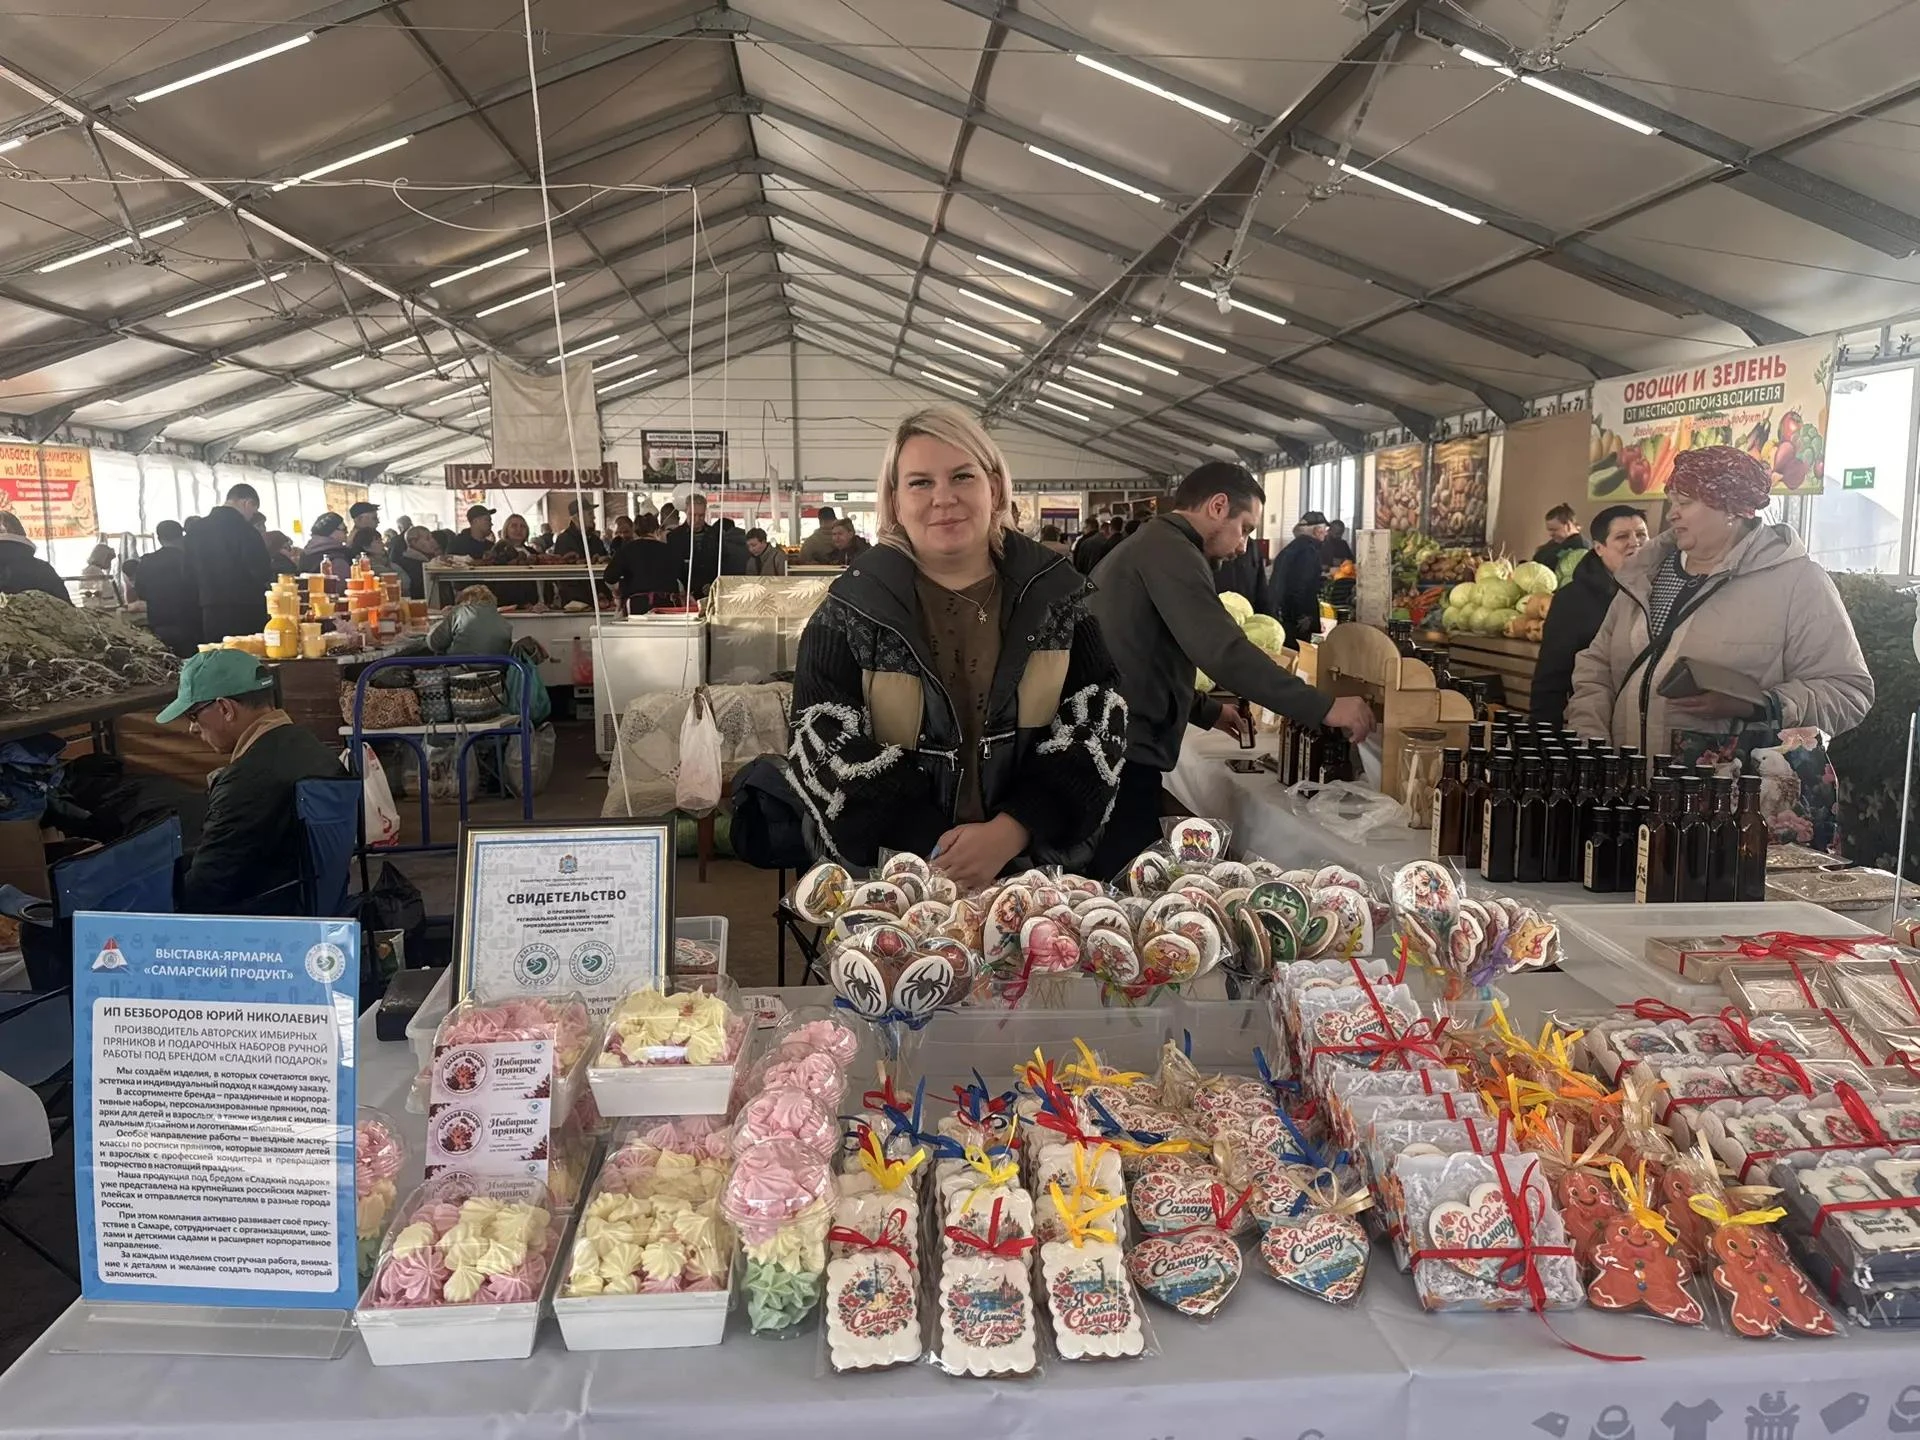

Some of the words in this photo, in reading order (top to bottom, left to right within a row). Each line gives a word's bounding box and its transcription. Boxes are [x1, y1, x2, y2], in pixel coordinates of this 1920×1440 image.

[1624, 371, 1687, 403] ОВОЩИ
[1693, 369, 1706, 391] И
[1712, 354, 1787, 388] ЗЕЛЕНЬ
[1625, 407, 1637, 421] ОТ
[1638, 400, 1686, 419] МЕСТНОГО
[1688, 385, 1782, 411] ПРОИЗВОДИТЕЛЯ
[507, 890, 626, 906] СВИДЕТЕЛЬСТВО
[155, 948, 283, 964] ВЫСТАВКА-ЯРМАРКА
[143, 964, 228, 979] «САМАРСКИЙ
[230, 967, 294, 982] ПРОДУКТ»
[103, 1006, 120, 1017] ИП
[124, 1007, 202, 1021] БЕЗБОРОДОВ
[206, 1008, 242, 1021] ЮРИЙ
[246, 1011, 327, 1024] НИКОЛАЕВИЧ
[114, 1024, 198, 1038] ПРОИЗВОДИТЕЛЬ
[201, 1028, 256, 1038] АВТОРСКИХ
[259, 1030, 316, 1040] ИМБИРНЫХ
[1340, 1020, 1385, 1042] Самару
[103, 1037, 155, 1047] ПРЯНИКОВ
[158, 1039, 165, 1047] И
[168, 1039, 236, 1051] ПОДАРОЧНЫХ
[239, 1041, 285, 1051] НАБОРОВ
[288, 1042, 327, 1053] РУЧНОЙ
[103, 1049, 141, 1058] РАБОТЫ
[144, 1050, 165, 1061] ПОД
[168, 1051, 215, 1063] БРЕНДОМ
[219, 1051, 271, 1065] «СЛАДКИЙ
[275, 1055, 327, 1067] ПОДАРОК»
[492, 1057, 542, 1068] Имбирные
[116, 1066, 132, 1074] Мы
[135, 1067, 170, 1077] создаём
[173, 1070, 211, 1079] изделия,
[221, 1072, 256, 1080] которых
[309, 1075, 330, 1083] вкус,
[495, 1066, 537, 1076] пряники
[143, 1077, 218, 1089] индивидуальный
[219, 1082, 251, 1090] подход
[257, 1083, 296, 1092] каждому
[298, 1084, 328, 1093] заказу.
[123, 1089, 182, 1099] ассортименте
[184, 1090, 215, 1100] бренда
[224, 1093, 281, 1102] праздничные
[291, 1095, 330, 1104] корпора-
[132, 1098, 168, 1109] наборы,
[170, 1101, 267, 1112] персонализированные
[270, 1105, 308, 1114] пряники,
[311, 1106, 330, 1115] под-
[488, 1117, 539, 1128] Имбирные
[491, 1126, 534, 1137] пряники
[117, 1170, 140, 1178] Наша
[143, 1173, 189, 1182] продукция
[209, 1174, 242, 1184] бредом
[245, 1175, 286, 1185] «Сладкий
[289, 1178, 330, 1187] подарок»
[101, 1181, 117, 1189] уже
[119, 1182, 177, 1192] представлена
[191, 1183, 243, 1194] крупнейших
[246, 1185, 294, 1196] российских
[296, 1188, 330, 1197] маркет-
[1156, 1184, 1177, 1200] Я
[101, 1190, 135, 1198] плейсах
[144, 1193, 200, 1203] отправляется
[203, 1195, 258, 1205] покупателям
[267, 1197, 298, 1206] разные
[300, 1198, 330, 1207] города
[101, 1200, 133, 1208] России.
[1154, 1199, 1215, 1221] Самару
[119, 1211, 135, 1221] При
[238, 1217, 280, 1226] развивает
[282, 1217, 300, 1225] своё
[303, 1219, 330, 1228] прису-
[137, 1221, 172, 1232] Самаре,
[174, 1224, 231, 1234] сотрудничает
[239, 1227, 308, 1237] организациями,
[1458, 1216, 1475, 1243] Я
[1467, 1216, 1516, 1249] Самару
[104, 1241, 161, 1251] направление.
[135, 1233, 175, 1242] детскими
[177, 1234, 208, 1243] садами
[219, 1236, 263, 1245] расширяет
[266, 1237, 331, 1247] корпоративное
[1282, 1232, 1300, 1250] Я
[1290, 1232, 1348, 1264] Самару
[132, 1253, 168, 1262] каждым
[170, 1254, 211, 1263] изделием
[237, 1257, 265, 1265] ручная
[268, 1256, 299, 1267] работа,
[1149, 1245, 1169, 1262] Я
[131, 1262, 167, 1271] деталям
[218, 1266, 250, 1274] создать
[254, 1267, 292, 1276] подарок,
[296, 1267, 331, 1277] который
[1151, 1251, 1217, 1277] Самару
[1071, 1292, 1086, 1308] Я
[849, 1308, 908, 1329] Самара
[1063, 1307, 1126, 1329] Самару
